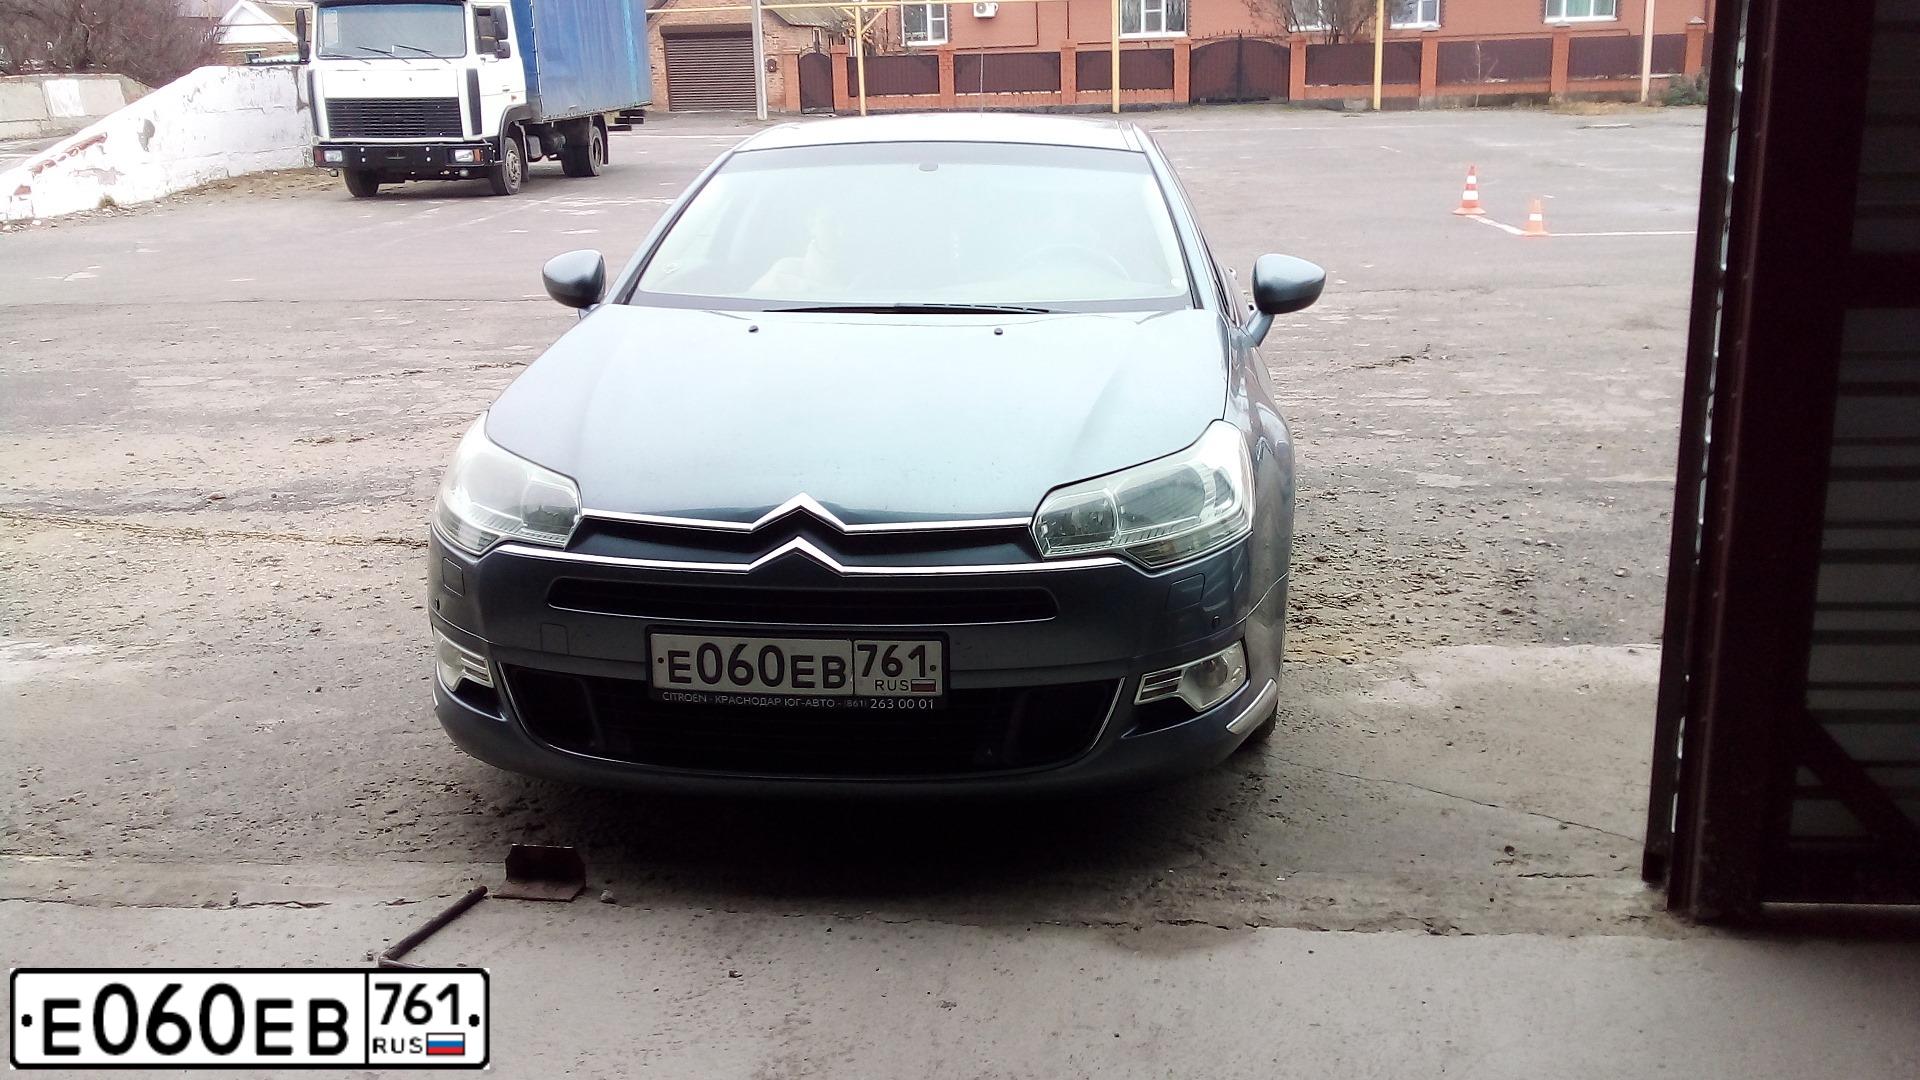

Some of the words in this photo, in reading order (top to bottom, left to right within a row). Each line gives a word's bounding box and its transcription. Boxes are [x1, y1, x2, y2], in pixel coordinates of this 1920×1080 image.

[857, 644, 926, 678] 761
[875, 679, 909, 691] RUS
[714, 696, 782, 708] КРАСНОДАР
[870, 699, 893, 709] 263
[898, 699, 915, 709] 00
[918, 699, 933, 710] 01
